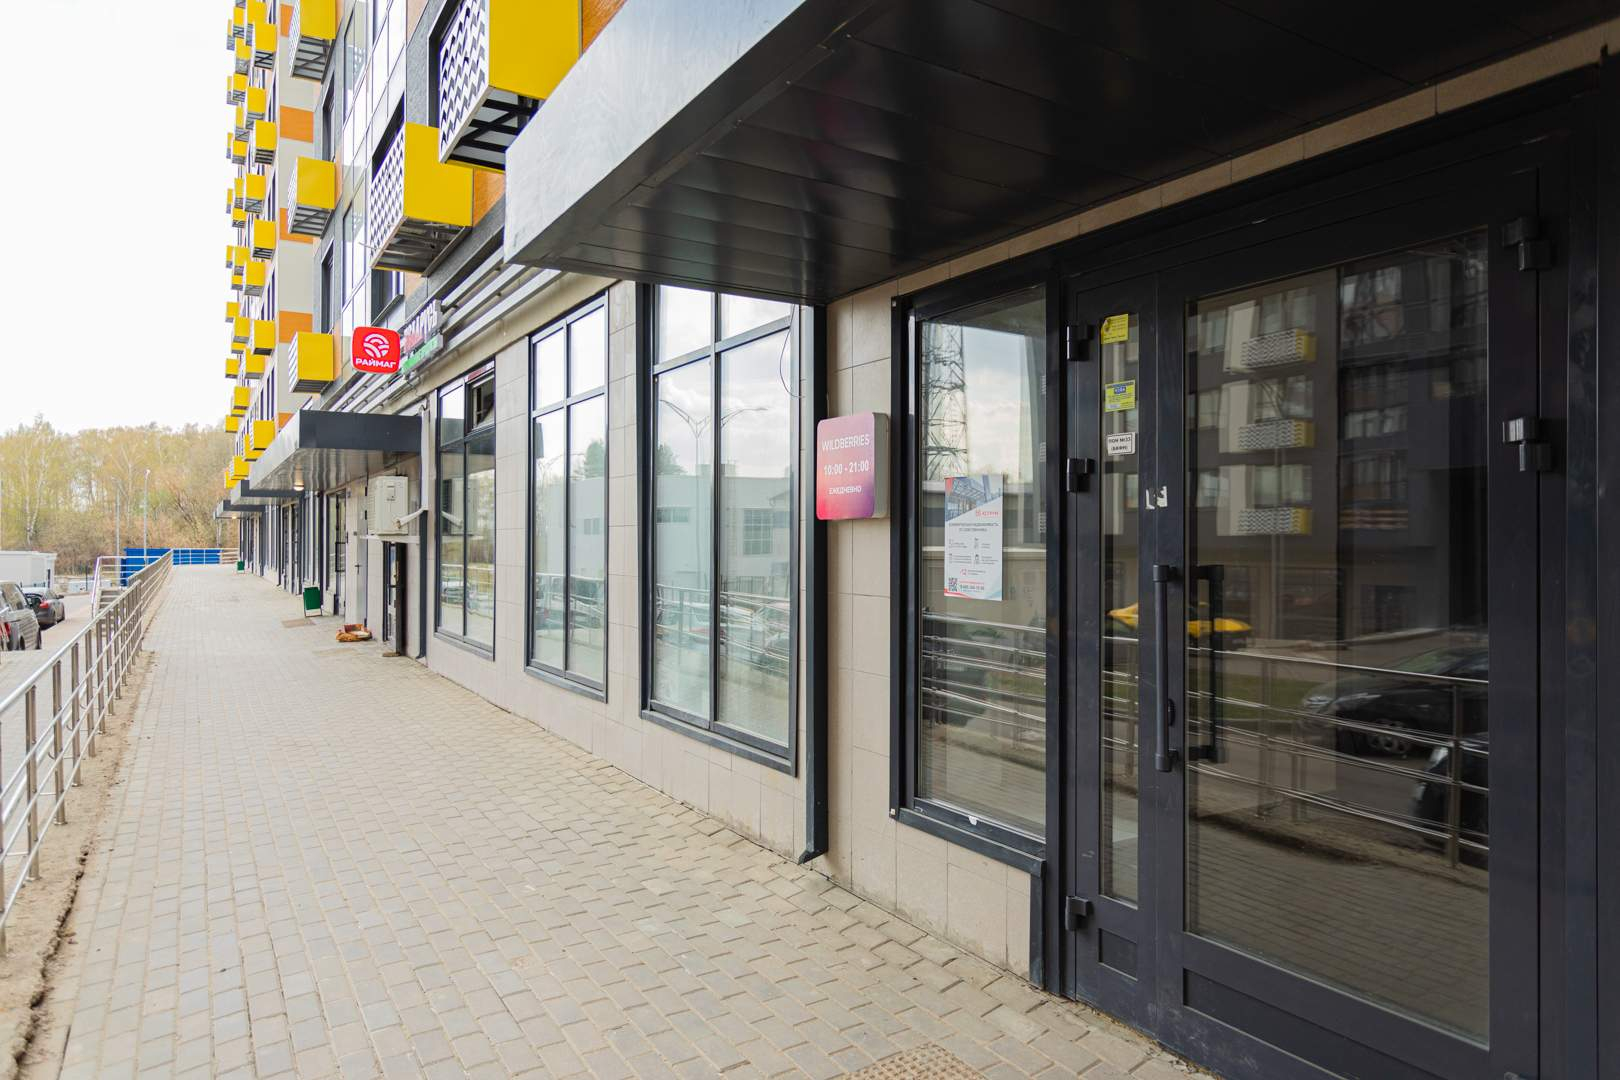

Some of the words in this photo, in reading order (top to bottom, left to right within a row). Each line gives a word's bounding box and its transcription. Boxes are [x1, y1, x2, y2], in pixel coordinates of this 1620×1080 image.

[355, 358, 396, 368] РАЙМАГ
[822, 434, 870, 451] WILDBERRIES
[823, 463, 843, 476] 10:00
[848, 460, 870, 473] 21:00
